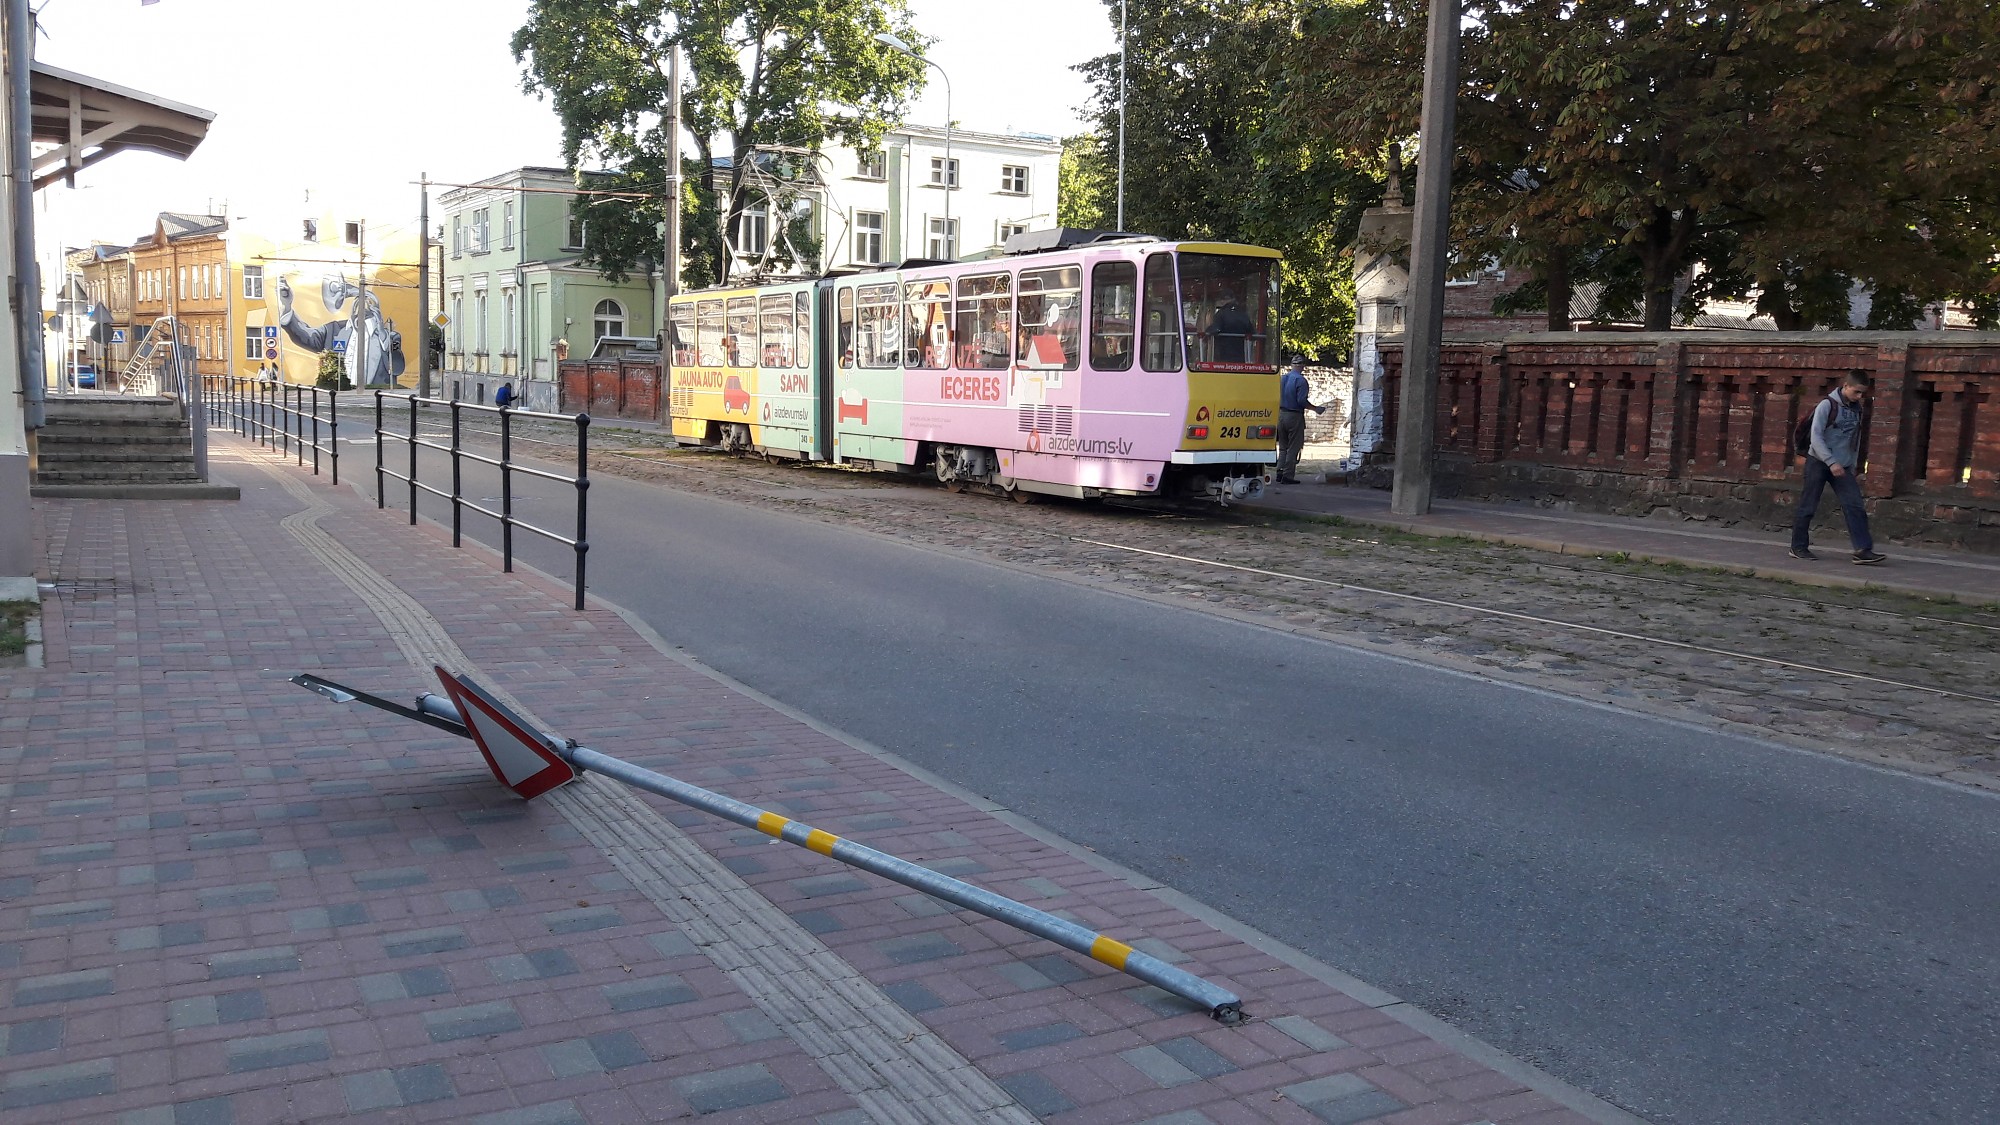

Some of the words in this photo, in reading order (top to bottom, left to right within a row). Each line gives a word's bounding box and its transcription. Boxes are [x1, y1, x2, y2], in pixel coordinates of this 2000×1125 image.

[678, 371, 701, 387] JAUNA
[702, 371, 723, 388] AUTO
[780, 374, 808, 393] SAPNI
[941, 376, 1000, 401] IECERES
[1220, 426, 1240, 438] 243
